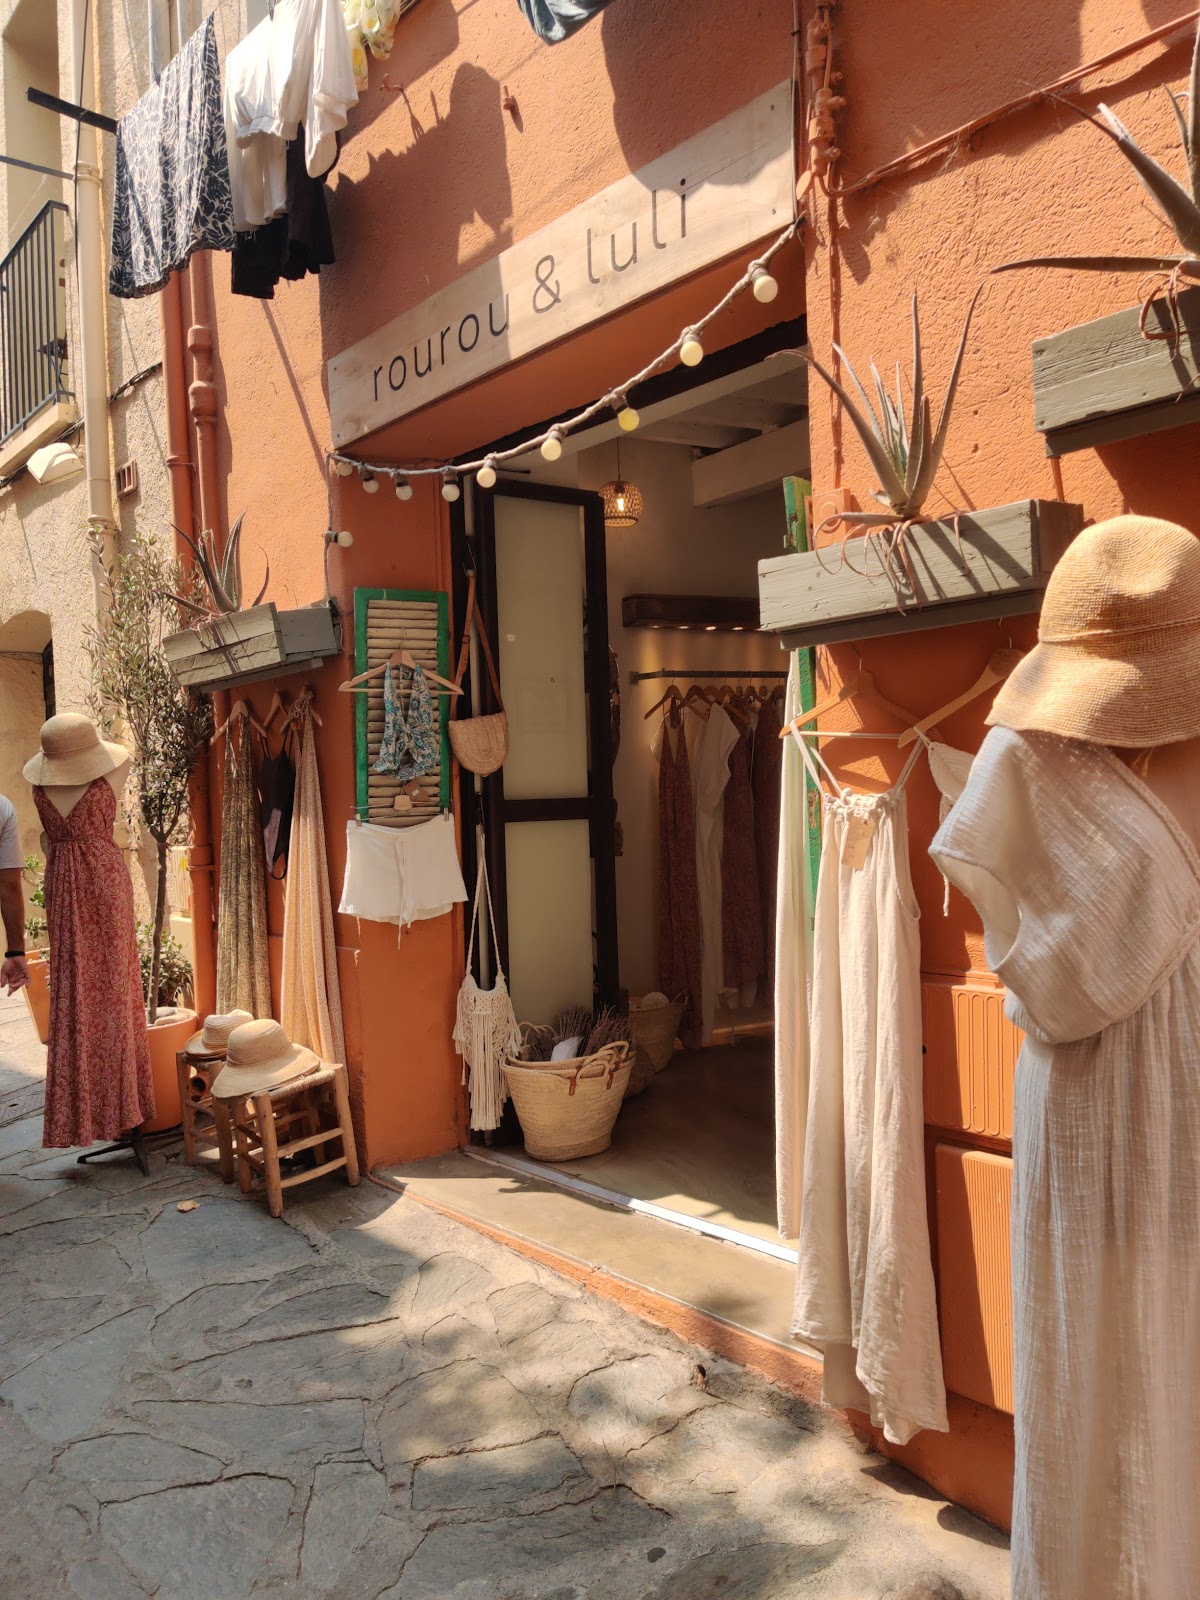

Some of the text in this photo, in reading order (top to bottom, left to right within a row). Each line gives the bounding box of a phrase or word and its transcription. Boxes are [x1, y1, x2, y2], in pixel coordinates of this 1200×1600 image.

[372, 178, 686, 401] rourou & luli
